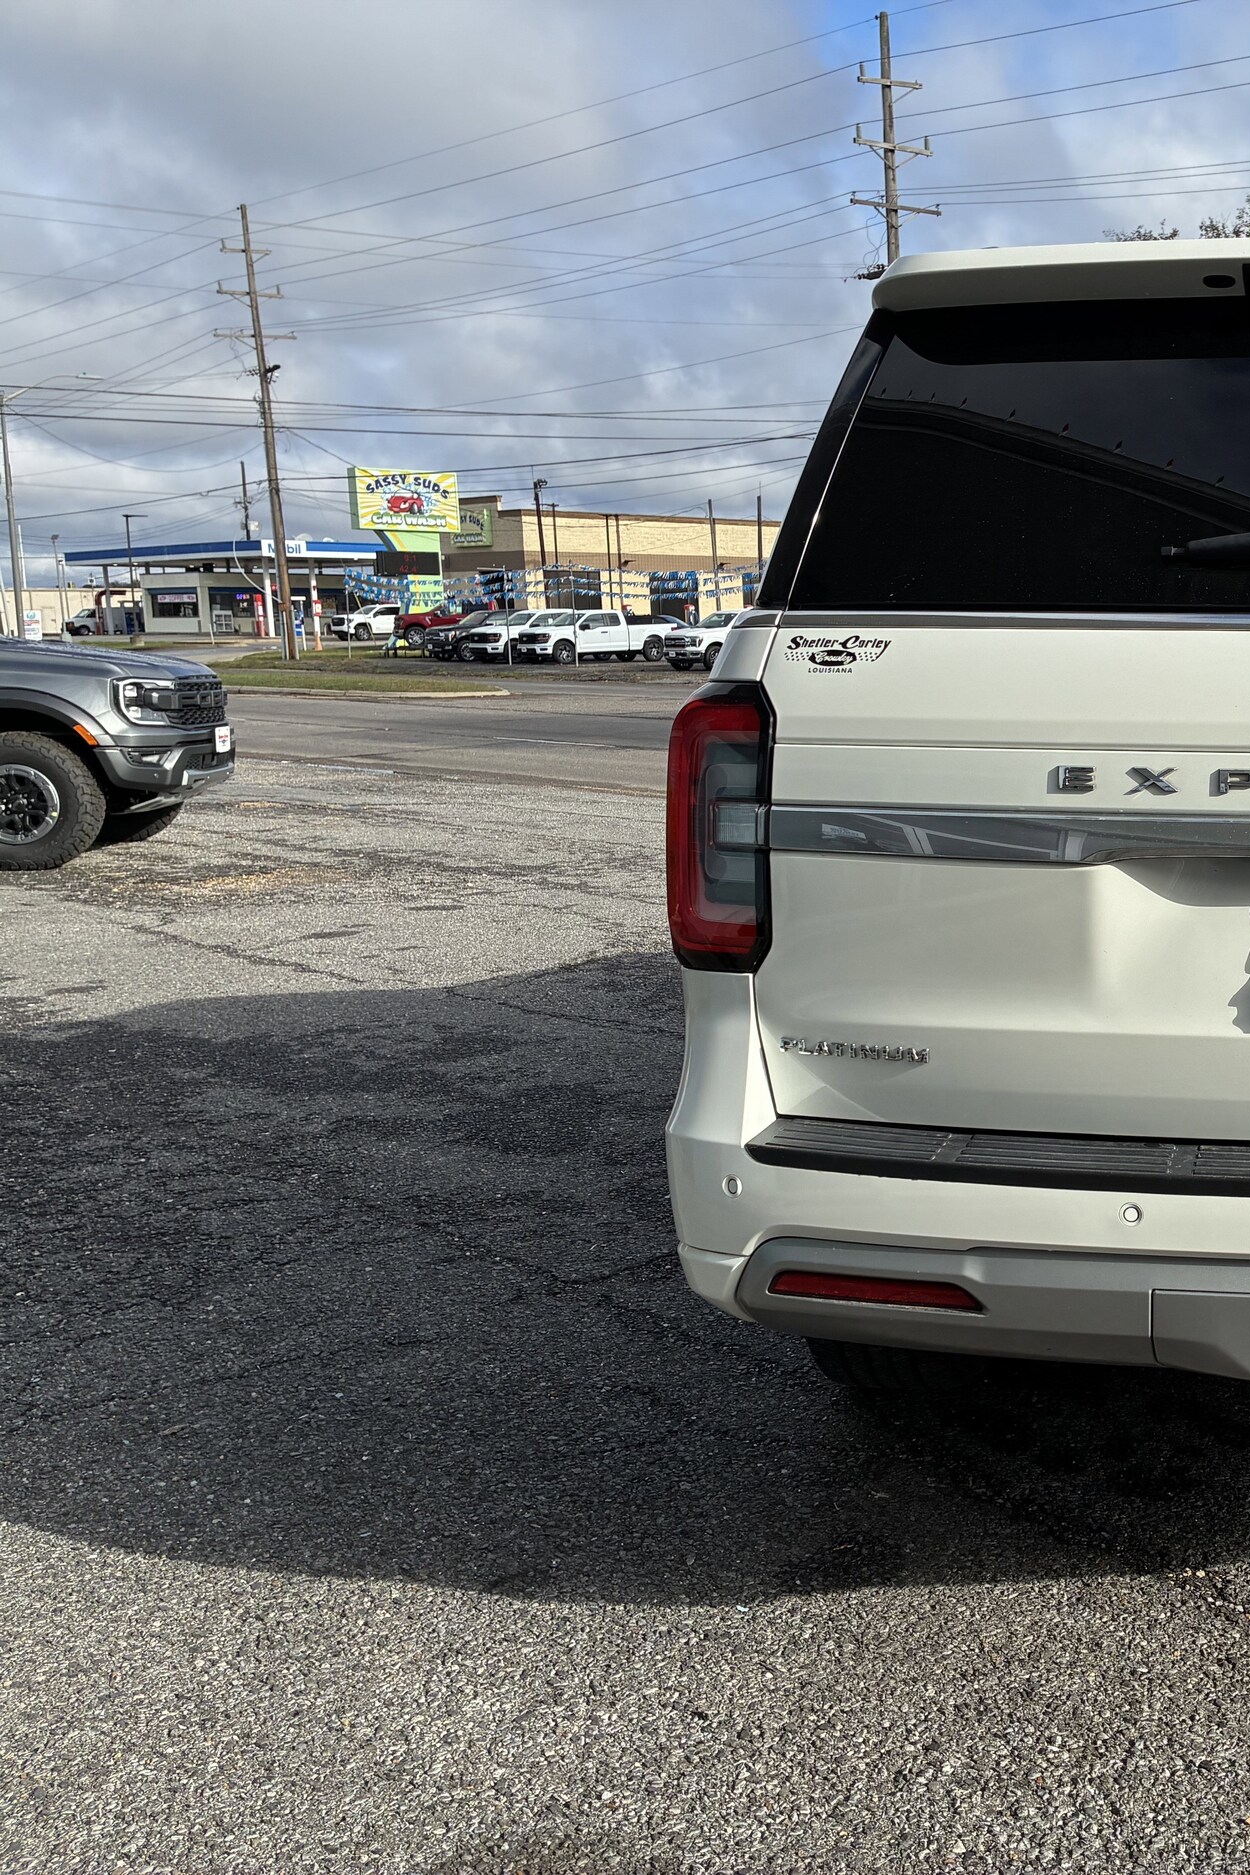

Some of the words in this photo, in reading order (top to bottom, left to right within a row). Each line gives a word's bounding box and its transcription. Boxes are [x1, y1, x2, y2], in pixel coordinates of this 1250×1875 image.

[366, 474, 407, 494] SASSY
[413, 476, 450, 500] SUDS
[371, 512, 403, 525] CAR
[404, 513, 448, 528] WASH
[267, 543, 302, 554] Mbil
[786, 635, 892, 662] Shetler-Corley
[814, 652, 854, 665] Crowley
[779, 1036, 931, 1063] PLATINUM
